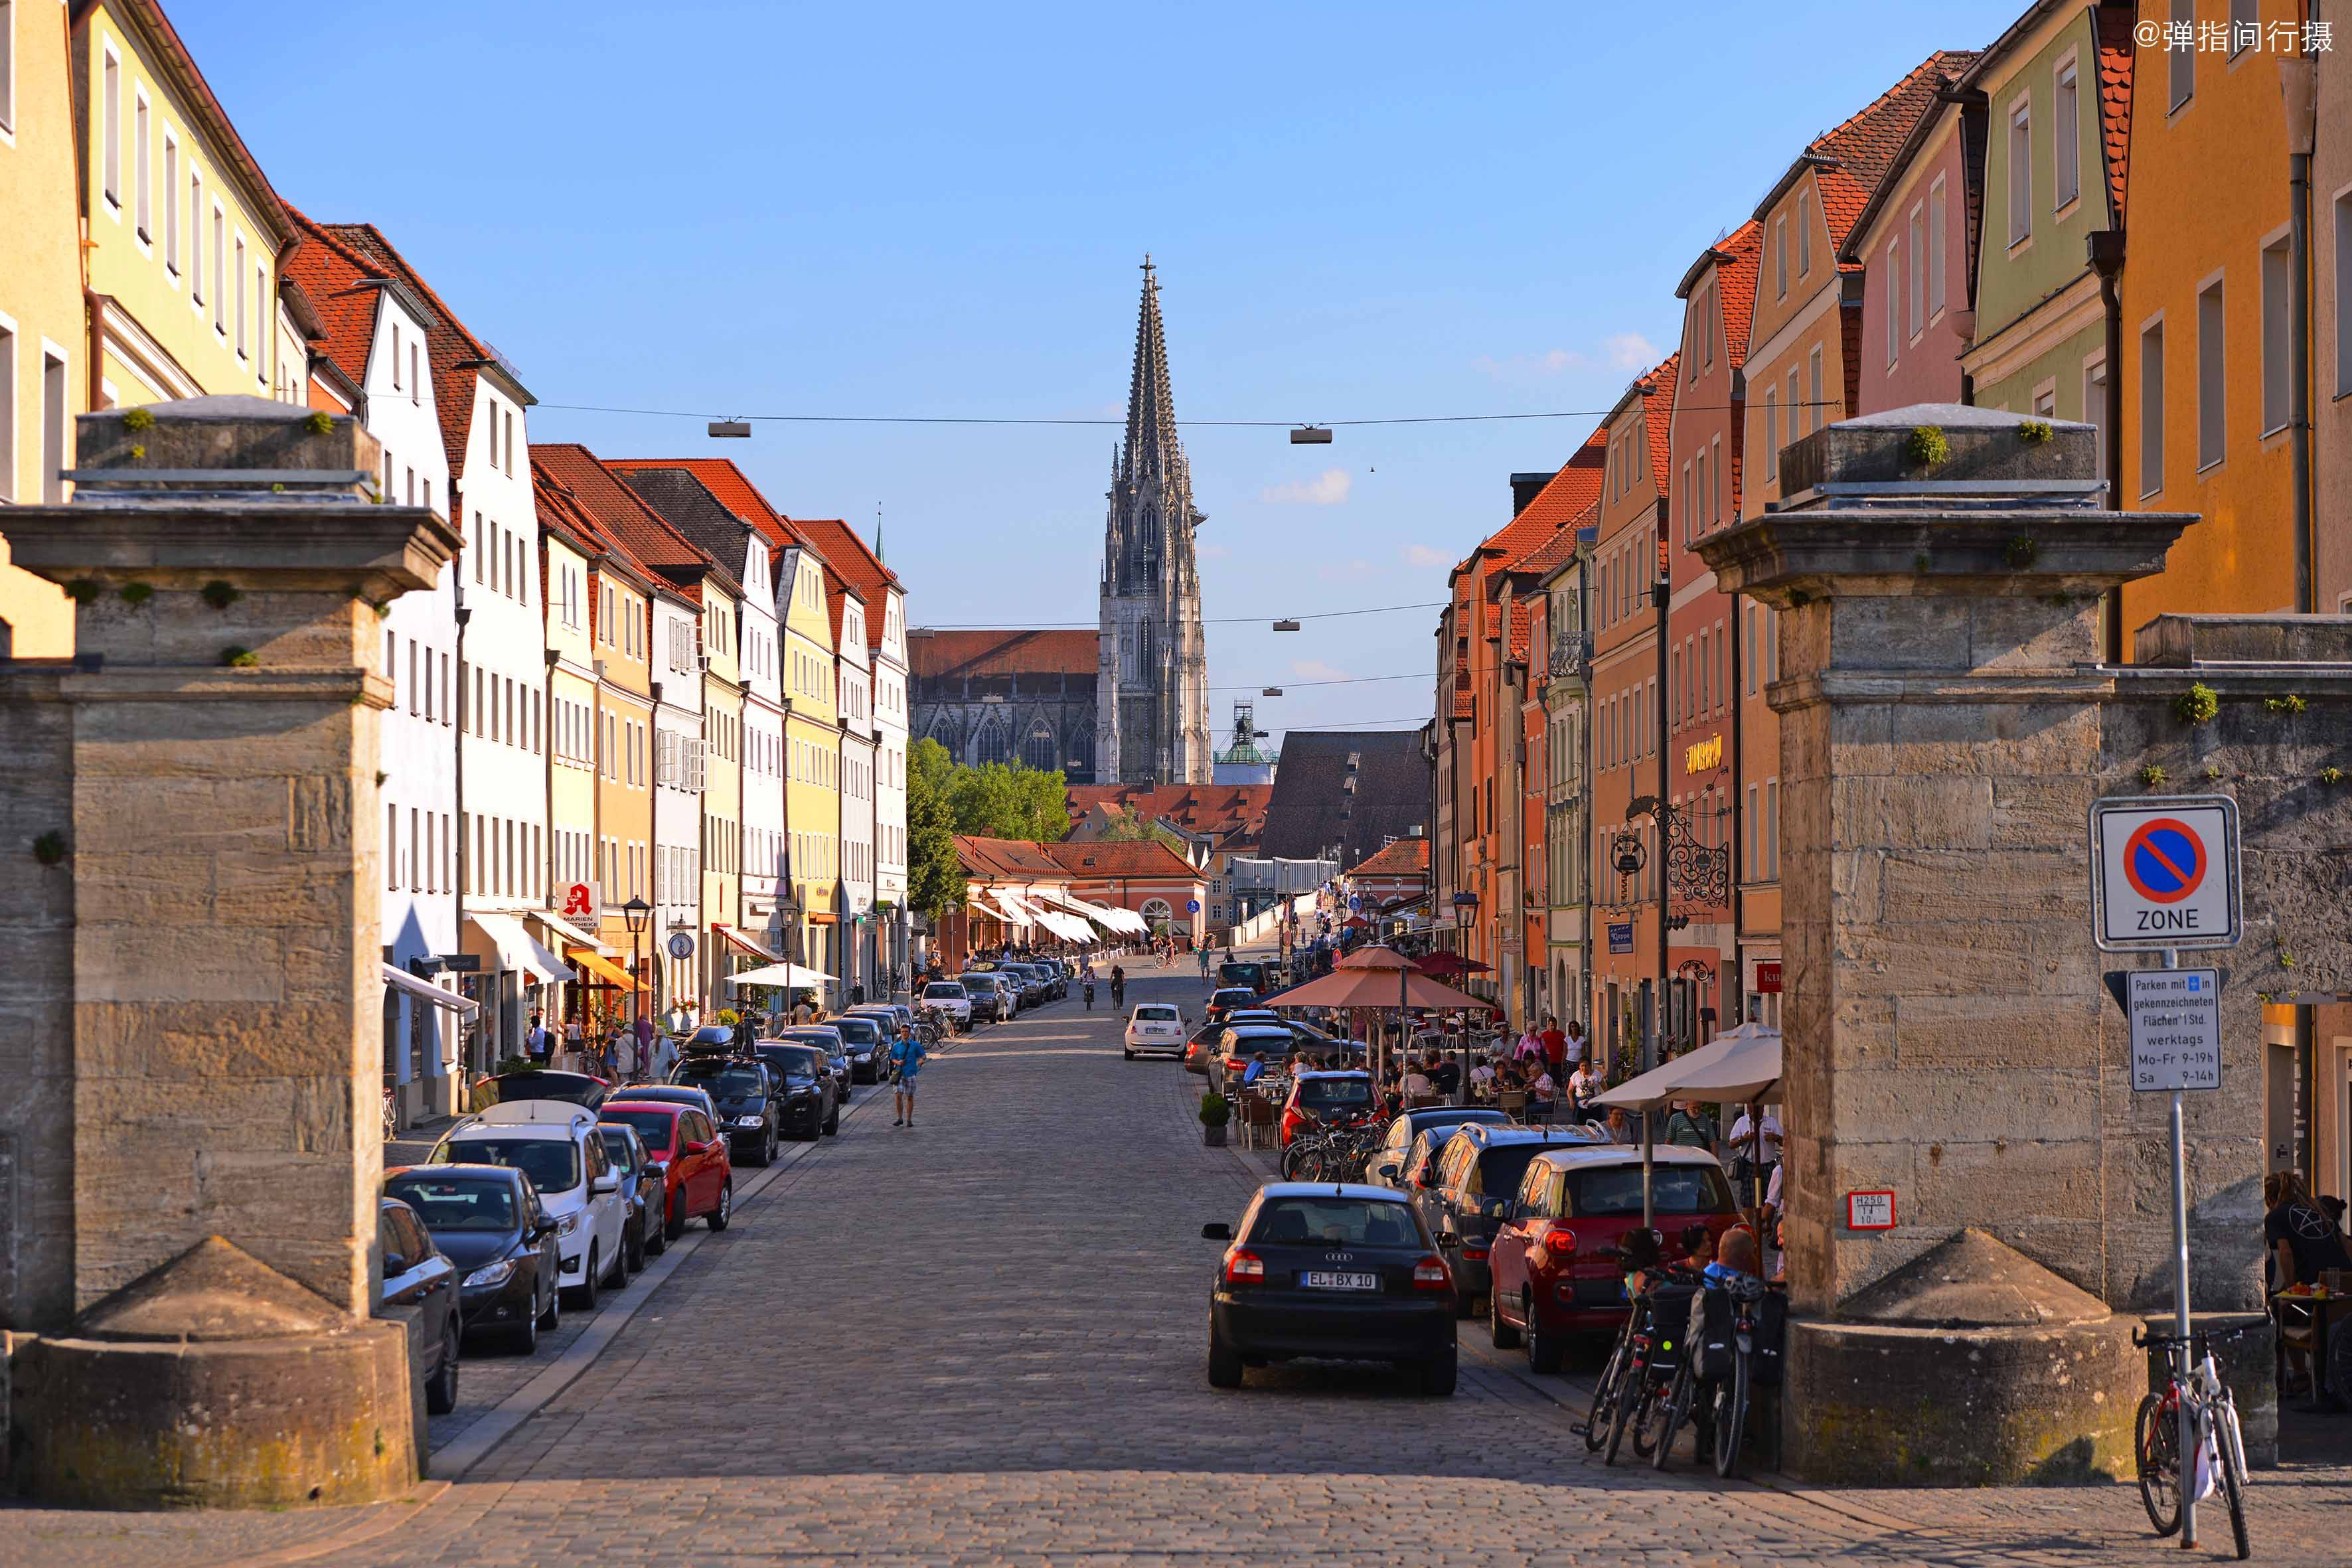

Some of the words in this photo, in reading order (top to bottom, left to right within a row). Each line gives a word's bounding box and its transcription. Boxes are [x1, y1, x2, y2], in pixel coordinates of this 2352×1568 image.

[2136, 909, 2199, 930] ZONE
[2136, 979, 2167, 990] Parken
[2171, 979, 2185, 989] mit
[2202, 977, 2210, 988] in
[2134, 996, 2214, 1011] gekennzeichneten
[2143, 1014, 2178, 1026] Flächen
[2147, 1034, 2204, 1047] werktags
[2138, 1053, 2176, 1065] Mo-Fr
[2140, 1072, 2154, 1083] Sa
[1310, 1273, 1327, 1286] EL
[1336, 1274, 1352, 1287] BX
[1356, 1275, 1372, 1287] 10
